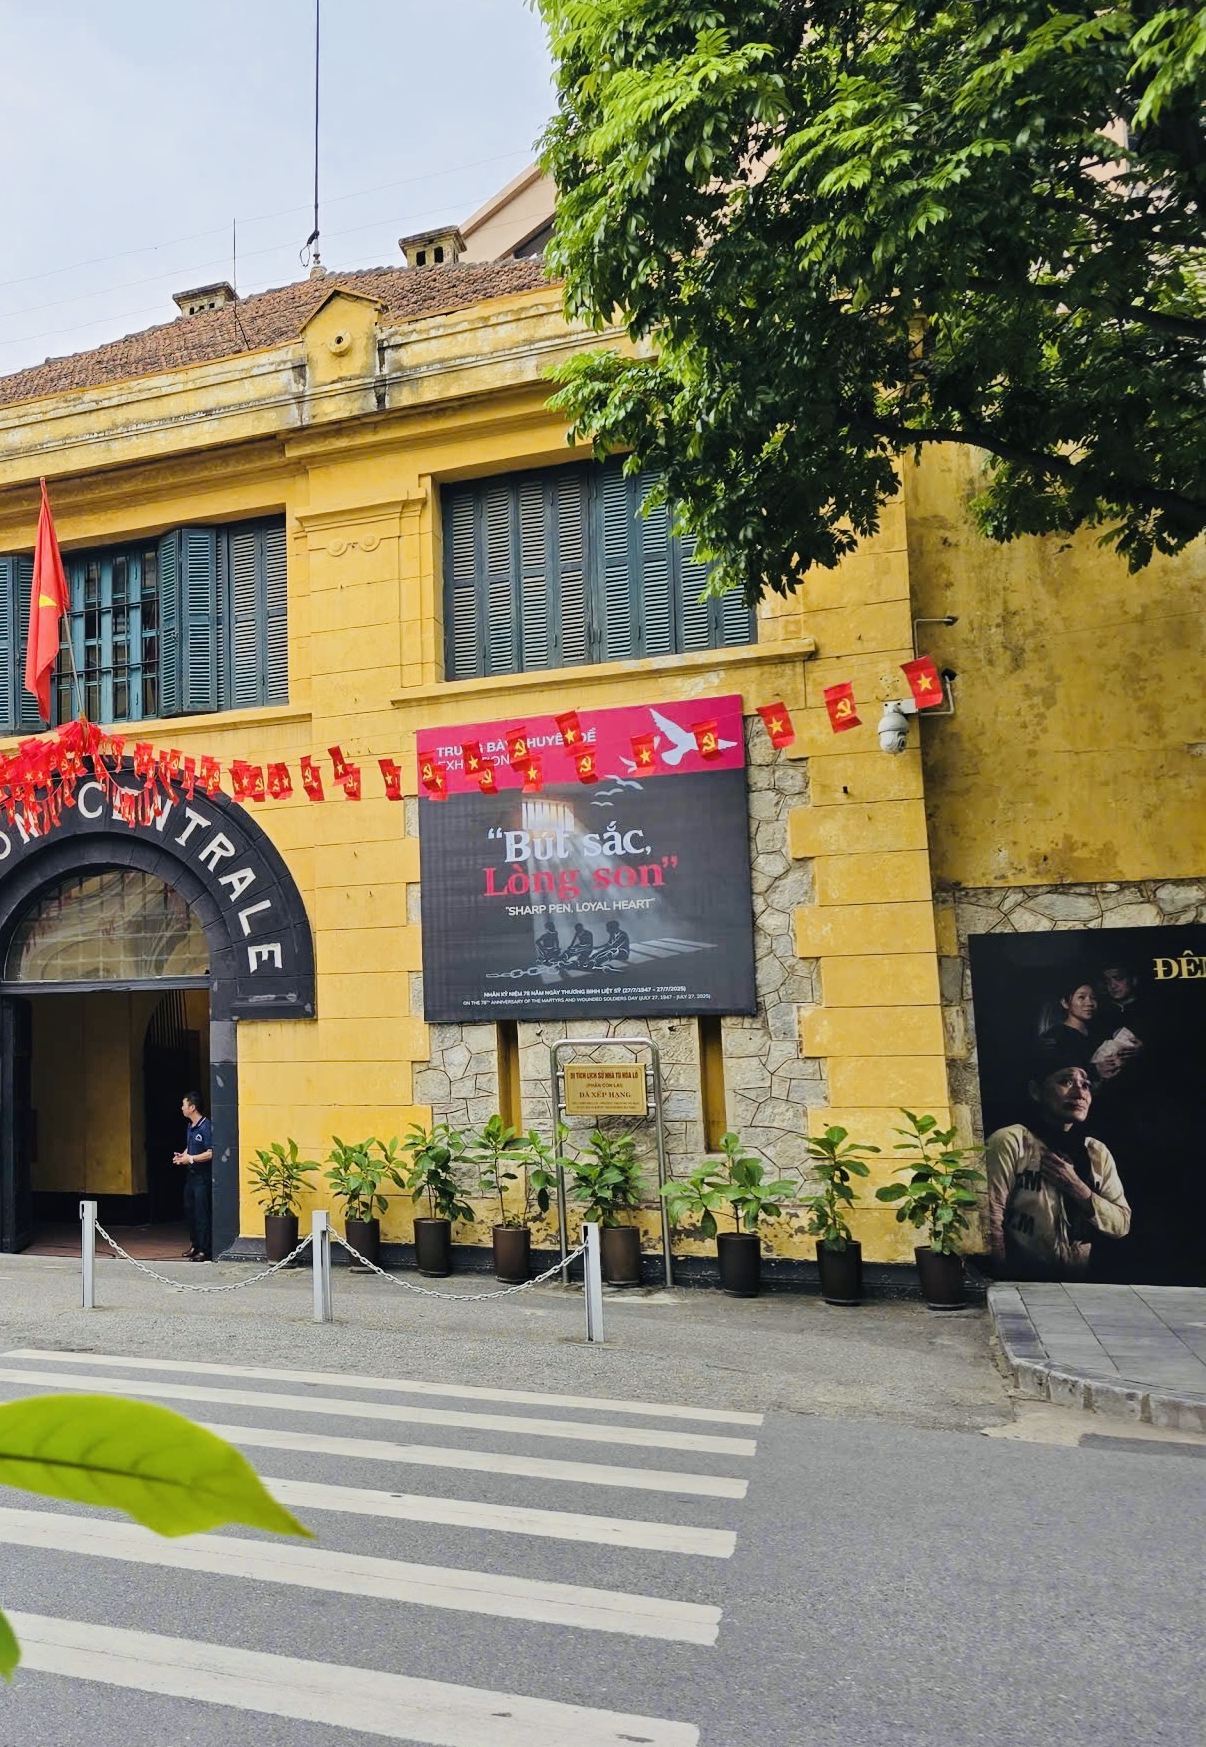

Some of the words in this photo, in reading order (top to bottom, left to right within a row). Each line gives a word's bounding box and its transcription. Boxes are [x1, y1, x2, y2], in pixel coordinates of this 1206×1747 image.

[436, 744, 483, 757] TRU
[487, 739, 509, 753] BÀ
[526, 733, 564, 748] HUYÊ
[482, 863, 580, 901] Lòng
[576, 901, 611, 913] LOYAL
[1153, 949, 1206, 980] ĐÊ
